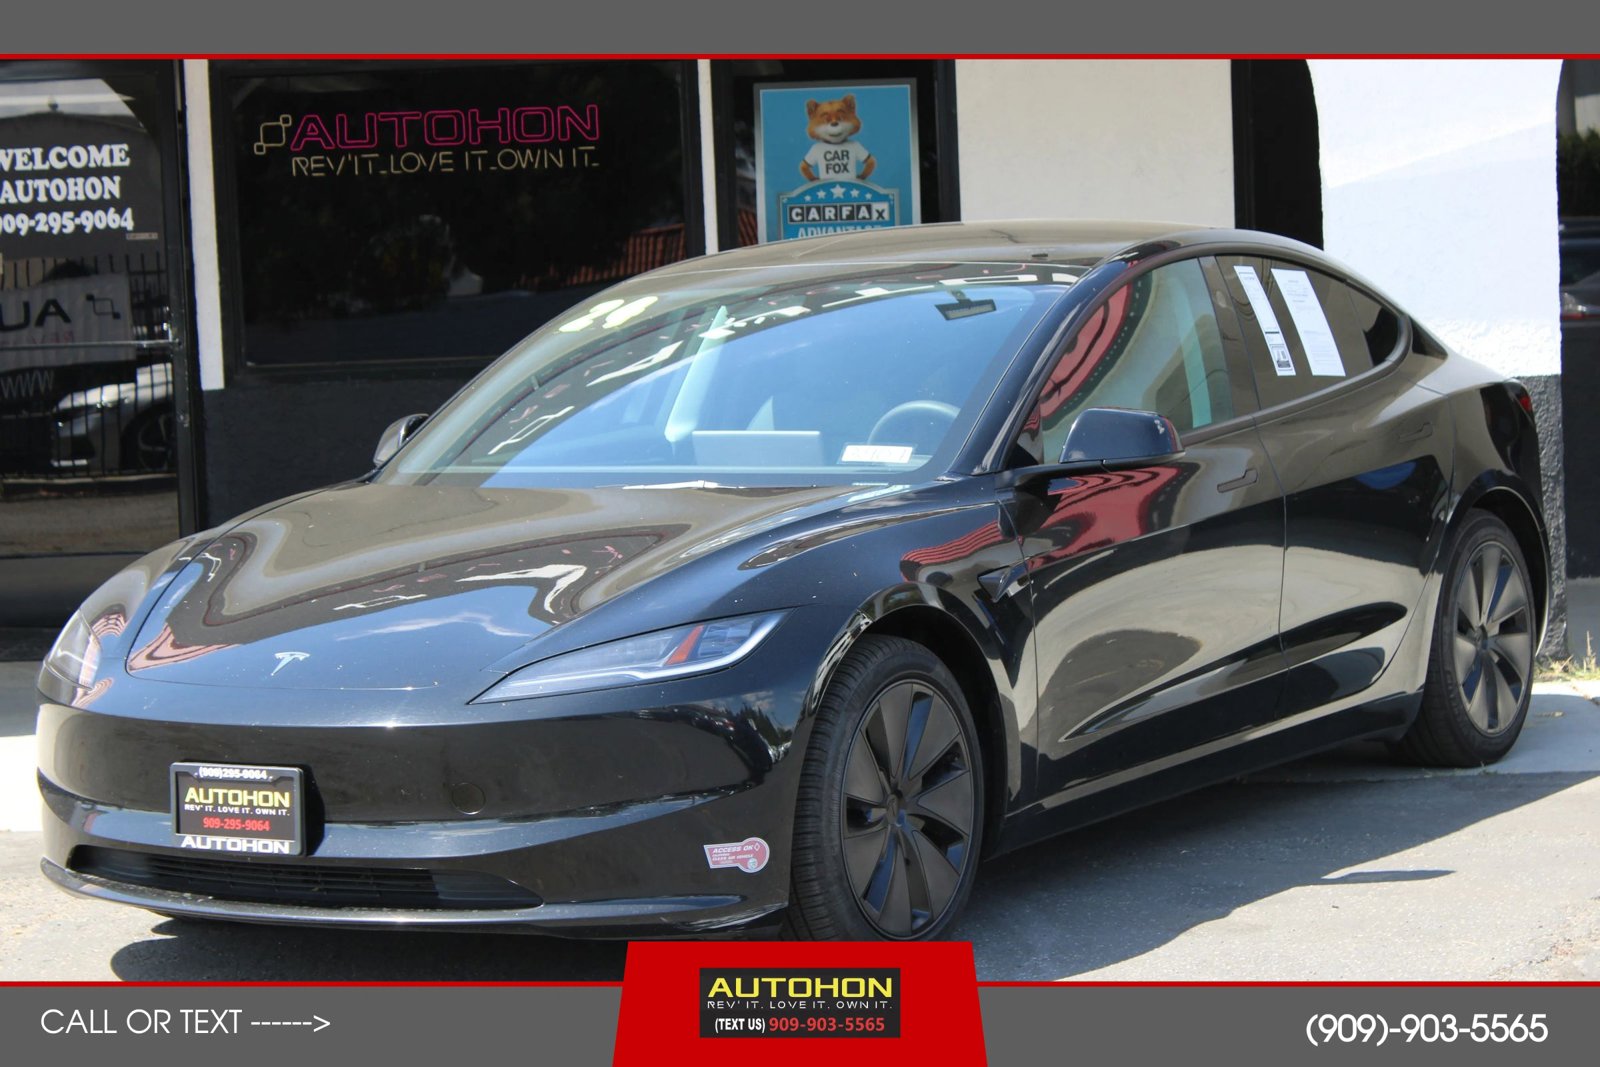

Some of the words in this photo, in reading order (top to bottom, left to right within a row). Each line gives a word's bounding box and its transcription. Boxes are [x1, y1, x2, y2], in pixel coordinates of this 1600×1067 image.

[289, 104, 600, 151] AUTOHON
[390, 151, 454, 174] LOVE
[823, 150, 850, 163] CAR
[825, 162, 850, 175] FOX
[0, 175, 121, 204] AUTOHON
[0, 207, 135, 236] 09-295-9064
[789, 204, 888, 222] CARFAX
[184, 786, 291, 808] AUTOHON
[218, 805, 240, 814] LOVE
[255, 807, 276, 816] OWN
[203, 816, 271, 832] 909-295-9064
[181, 835, 290, 855] AUTOHON
[743, 844, 754, 852] OK
